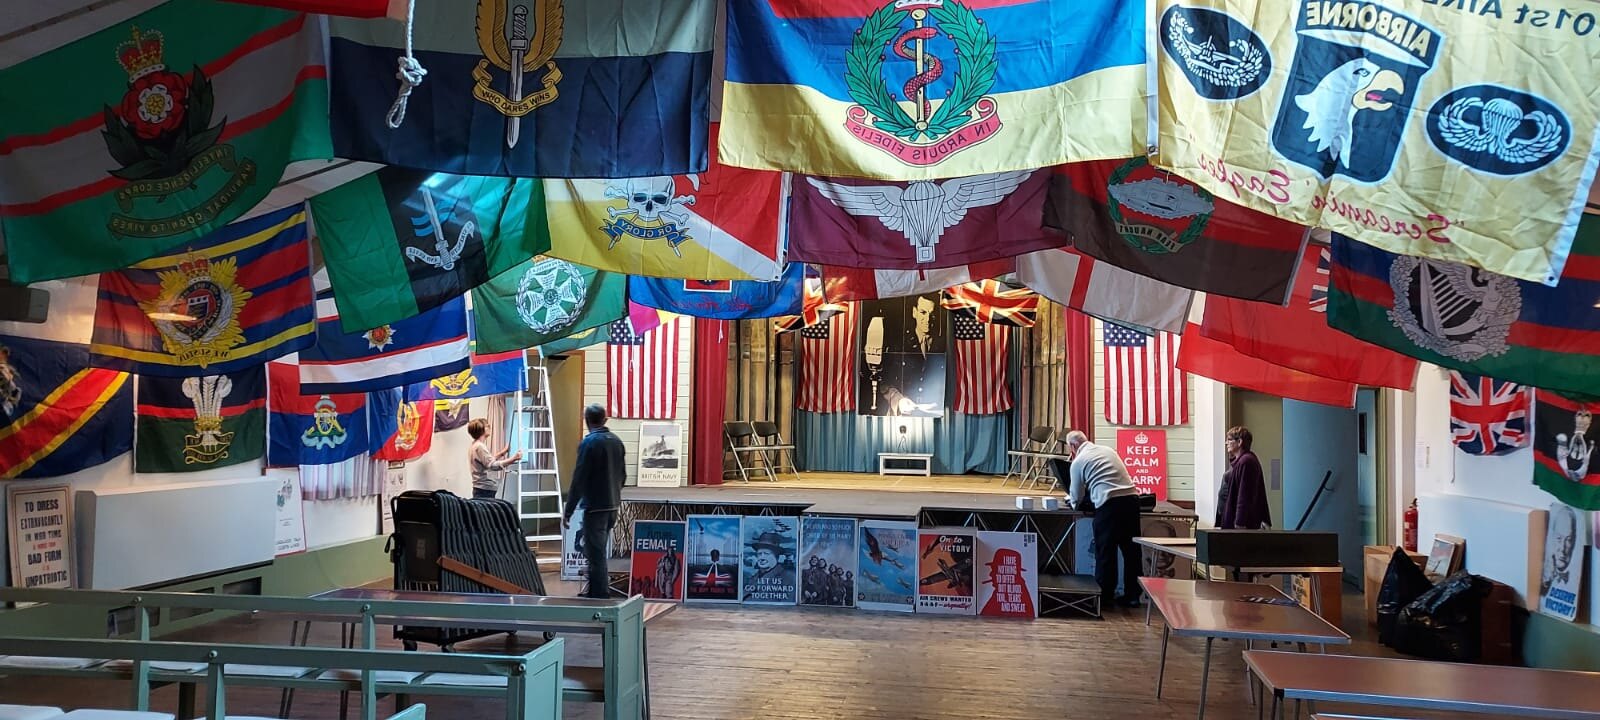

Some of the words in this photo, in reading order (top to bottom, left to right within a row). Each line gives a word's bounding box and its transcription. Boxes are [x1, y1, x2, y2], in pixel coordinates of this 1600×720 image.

[482, 90, 500, 104] WHO
[501, 102, 528, 112] DARES
[530, 92, 551, 104] WINS
[1126, 446, 1158, 455] KEEP
[1124, 458, 1158, 467] CALM
[1130, 476, 1162, 485] ARRY
[25, 502, 34, 512] TO
[37, 499, 59, 511] DRESS
[20, 514, 63, 530] EXTRAVAGANTLY
[636, 539, 677, 550] FEMALE
[28, 553, 42, 565] BAD
[45, 550, 62, 562] FORM
[25, 570, 67, 588] UNPATRIOTIC
